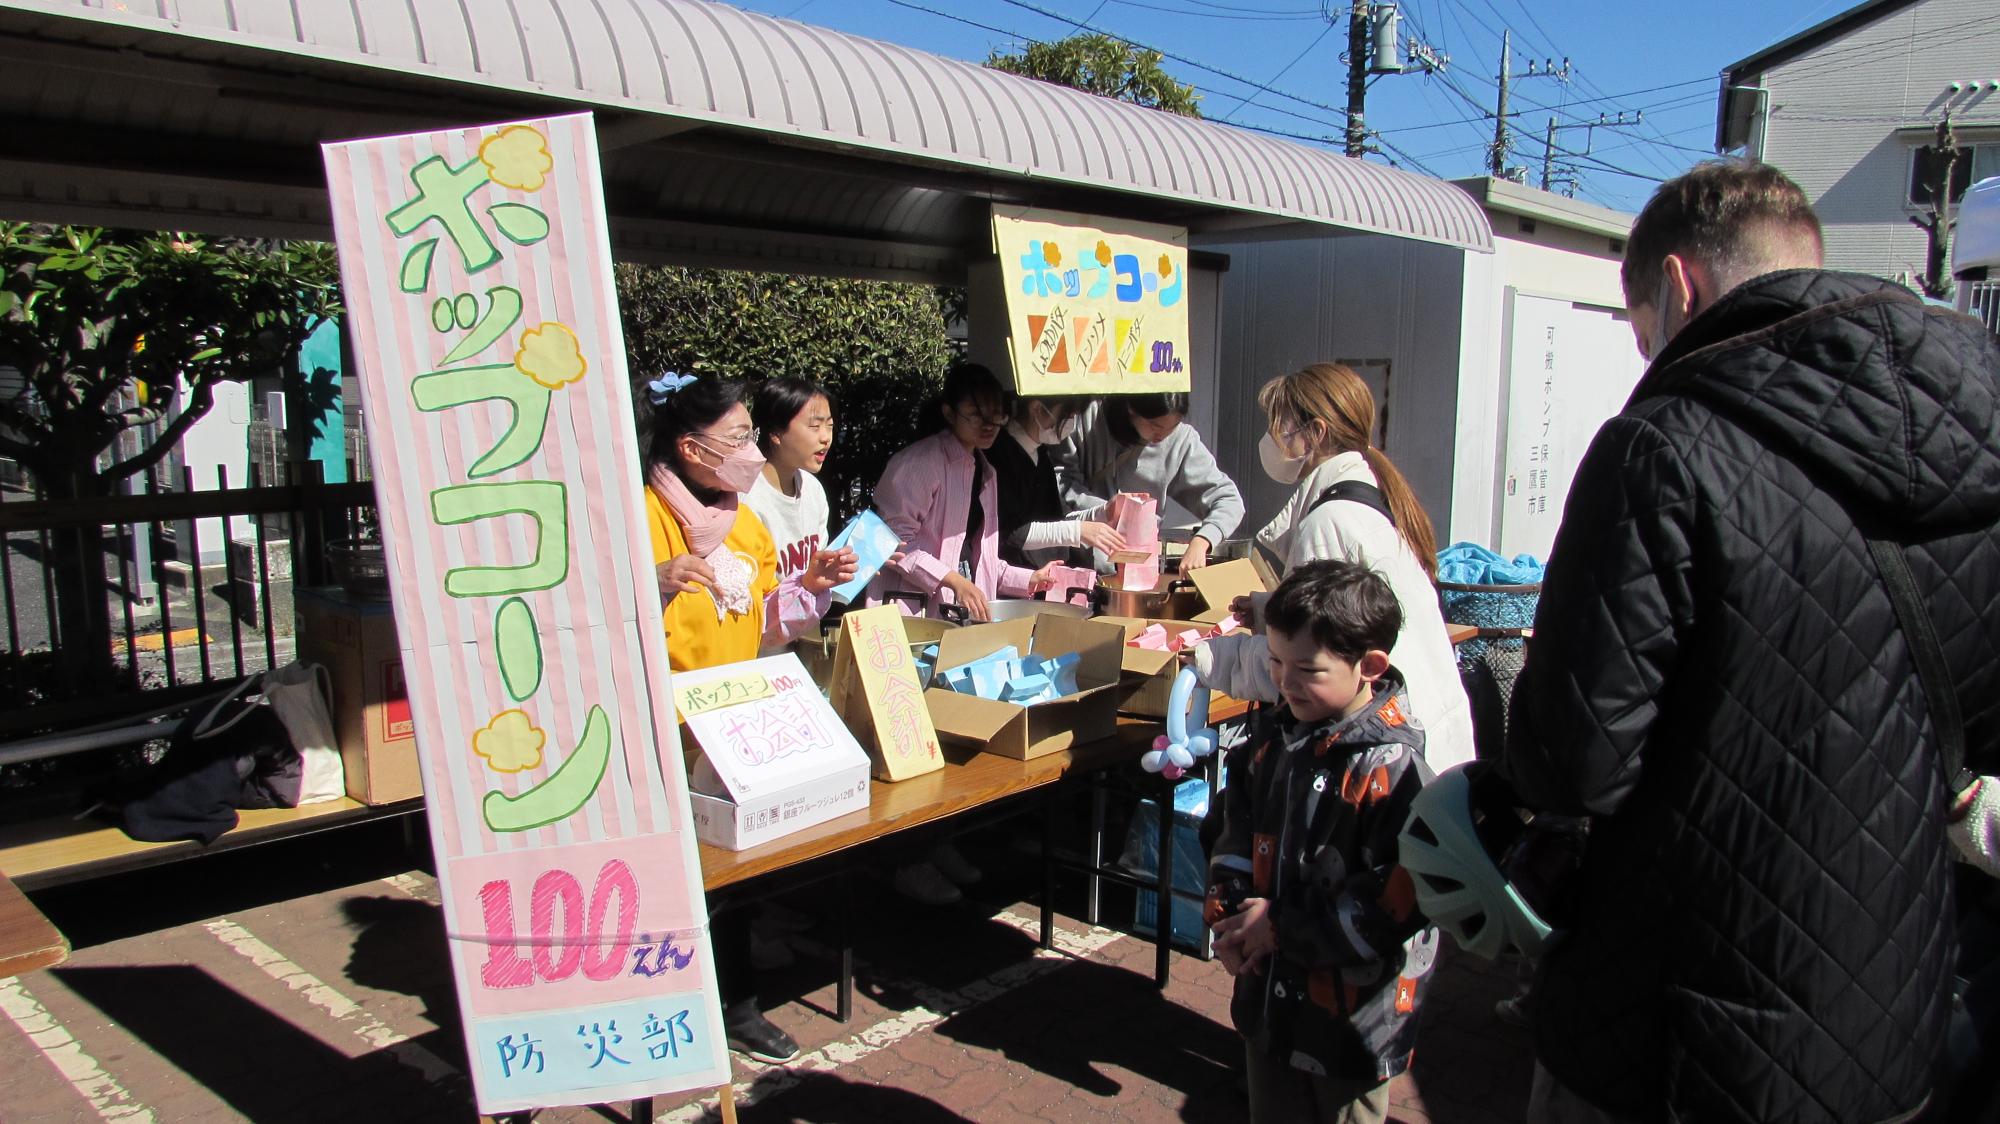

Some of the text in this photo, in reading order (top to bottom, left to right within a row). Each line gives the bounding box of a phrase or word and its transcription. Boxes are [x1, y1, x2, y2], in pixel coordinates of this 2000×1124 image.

[1020, 240, 1182, 308] ポップコーン
[386, 125, 612, 832] ポップコーン
[684, 674, 769, 711] ポップコーン
[497, 1009, 694, 1078] 防災部
